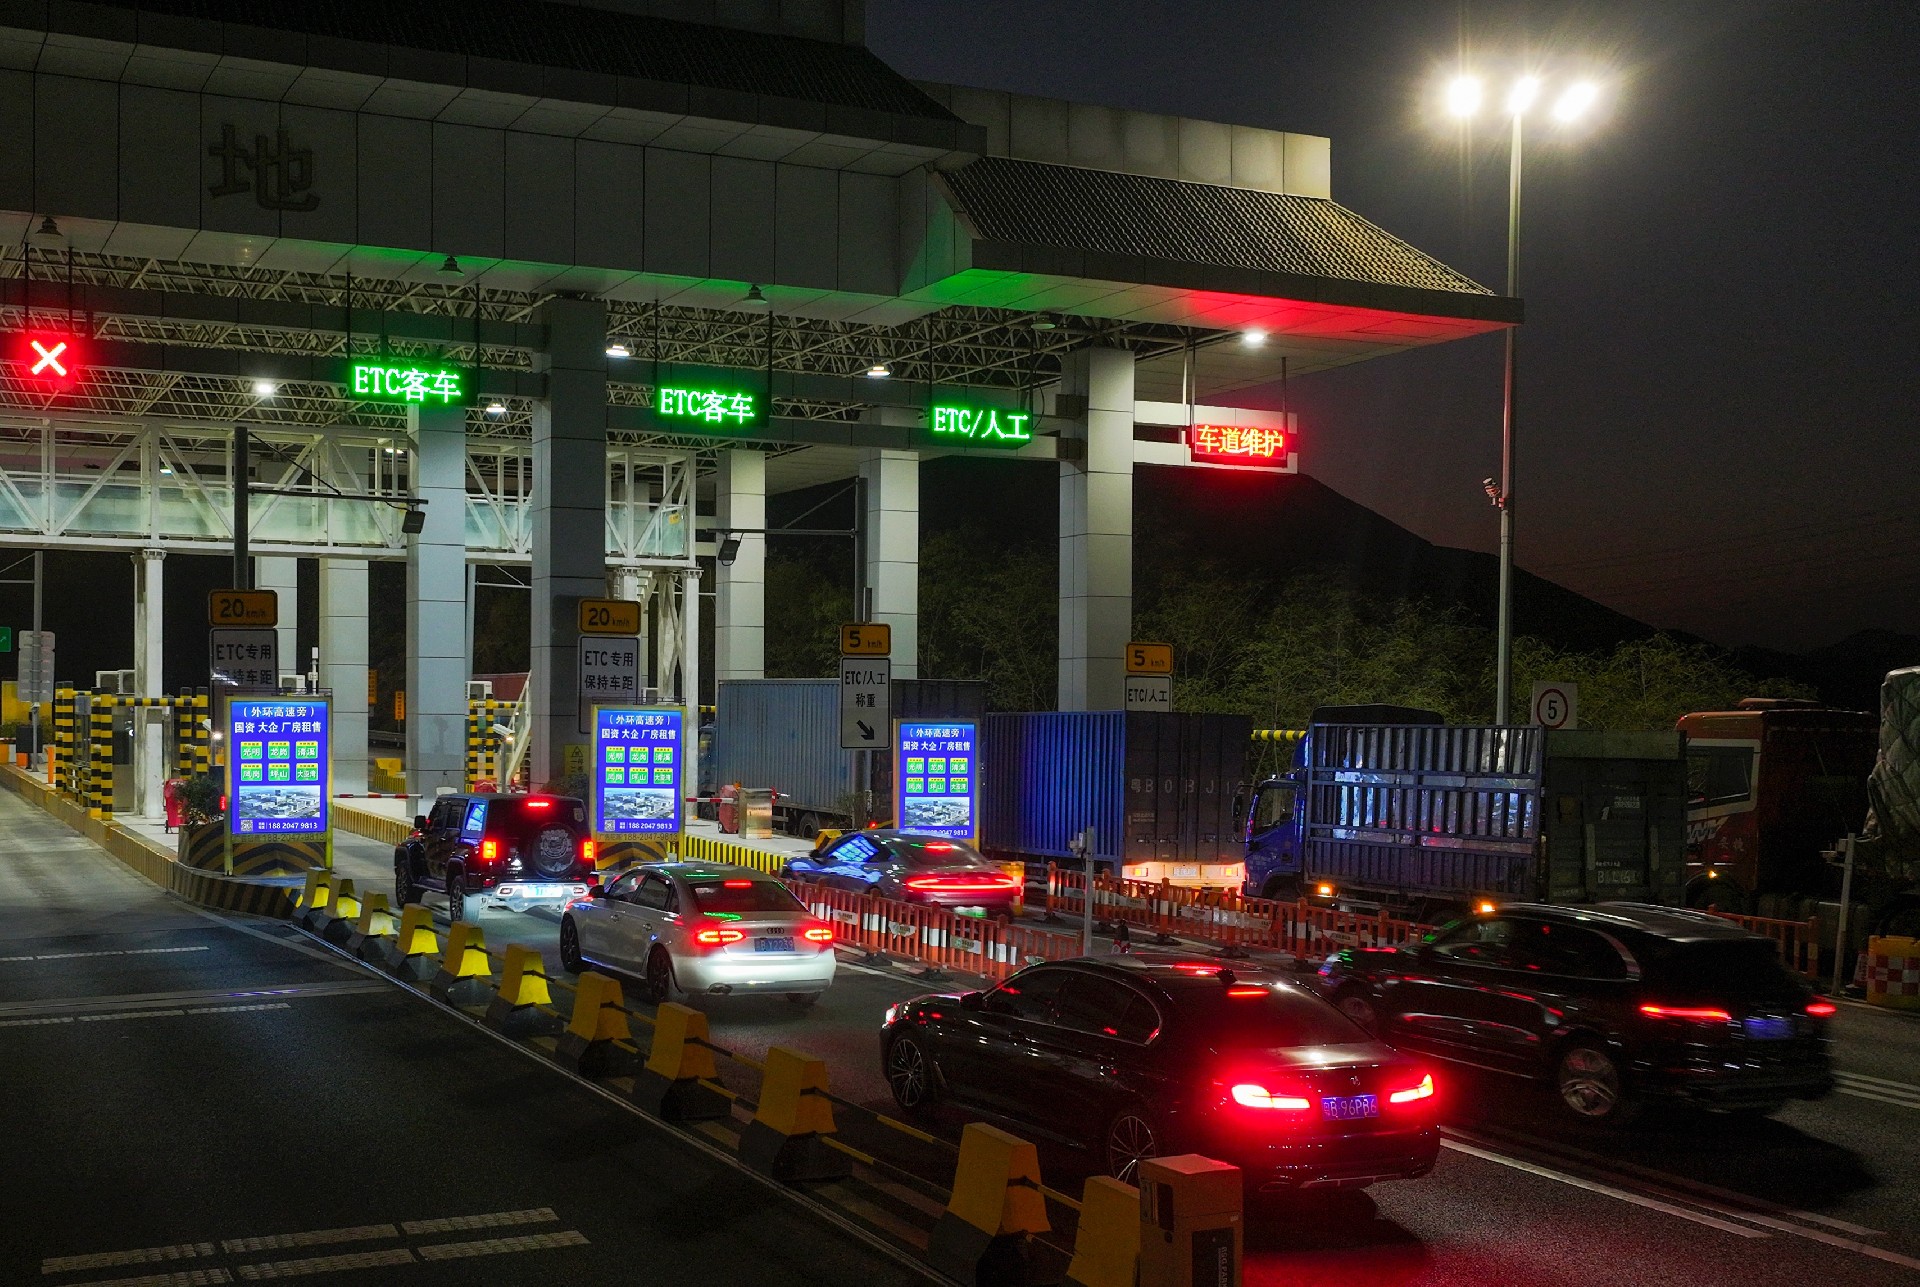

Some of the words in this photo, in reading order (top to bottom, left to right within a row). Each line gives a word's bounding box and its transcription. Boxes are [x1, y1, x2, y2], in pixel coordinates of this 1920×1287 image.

[208, 124, 320, 211] 地
[355, 366, 461, 403] ETC客车
[661, 388, 755, 424] ETC客车
[934, 407, 1030, 439] ETC/人工
[1196, 425, 1283, 457] 车道维护
[220, 598, 244, 617] 20
[588, 607, 609, 626] 20
[849, 630, 861, 648] 5
[1134, 650, 1145, 666] 5
[585, 674, 633, 690] 保持车距
[845, 670, 886, 685] ETC/人工
[855, 693, 875, 708] 称重
[1128, 688, 1167, 702] ETC/人工
[1548, 699, 1558, 719] 5
[234, 722, 255, 733] 国资
[258, 722, 278, 733] 大企
[281, 722, 321, 733] 厂房租售
[601, 728, 619, 739] 国资
[621, 729, 639, 739] 大企
[641, 729, 676, 740] 厂房租售
